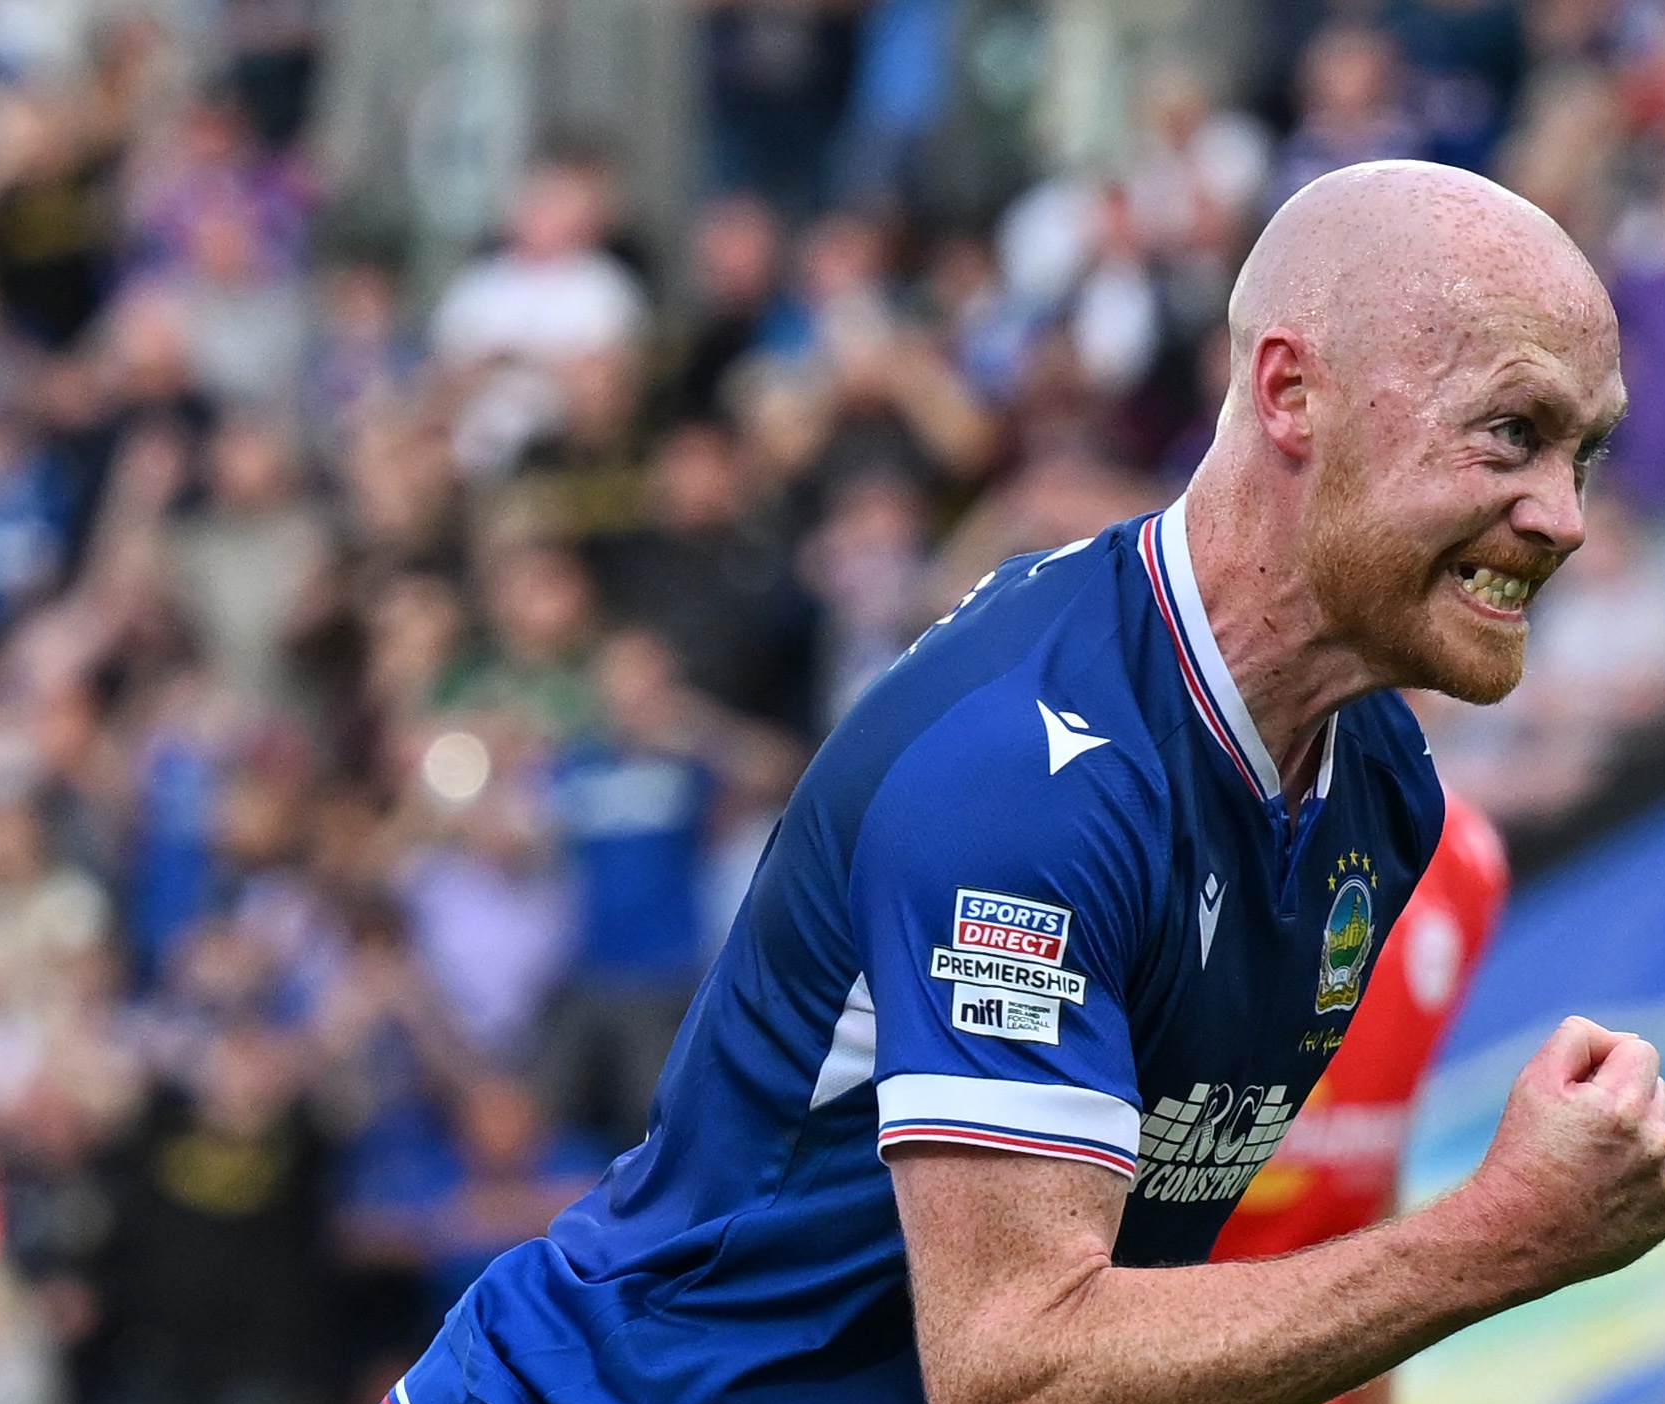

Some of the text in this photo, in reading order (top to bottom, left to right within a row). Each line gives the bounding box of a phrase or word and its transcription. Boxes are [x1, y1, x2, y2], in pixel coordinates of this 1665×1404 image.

[966, 899, 1059, 933] SPORTS
[963, 924, 1054, 956] DIRECT
[936, 954, 1080, 995] PREMIERSHIP
[960, 998, 1003, 1029] nifl
[1008, 1001, 1050, 1013] NORTHERN
[1008, 1008, 1040, 1019] IRELAND
[1008, 1015, 1050, 1028] FOOTBALL
[1176, 1083, 1265, 1165] RC
